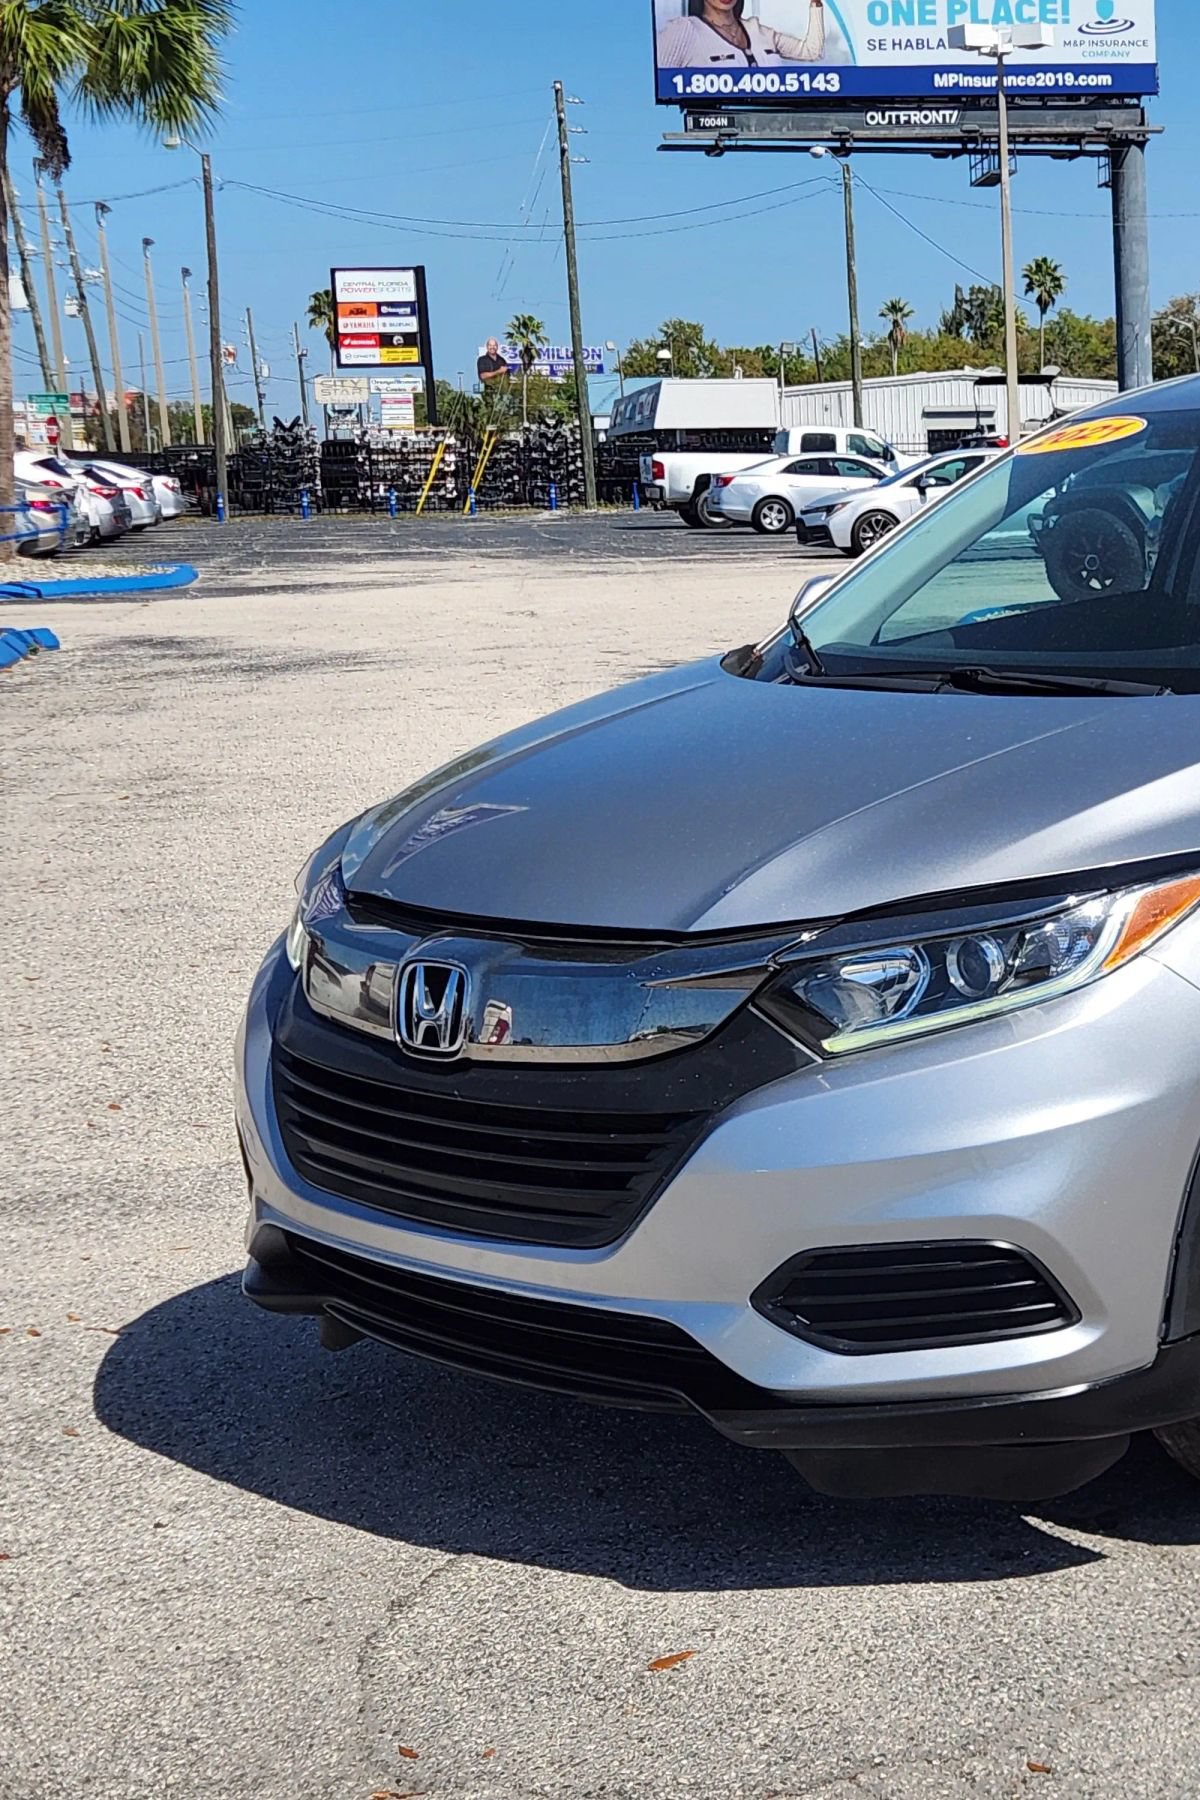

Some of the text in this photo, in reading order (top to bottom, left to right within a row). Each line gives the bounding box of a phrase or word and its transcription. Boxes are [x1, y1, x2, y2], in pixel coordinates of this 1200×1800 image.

[867, 0, 1070, 26] ONE PLACE!
[867, 38, 945, 51] SE HABLA
[1063, 39, 1149, 48] M&P INSURANCE
[1081, 50, 1131, 58] COMPANY
[672, 72, 841, 94] 1.800.400.5143
[698, 117, 728, 127] 7004N
[538, 347, 602, 361] MILLON
[320, 379, 361, 388] CITY
[320, 388, 362, 397] STAR
